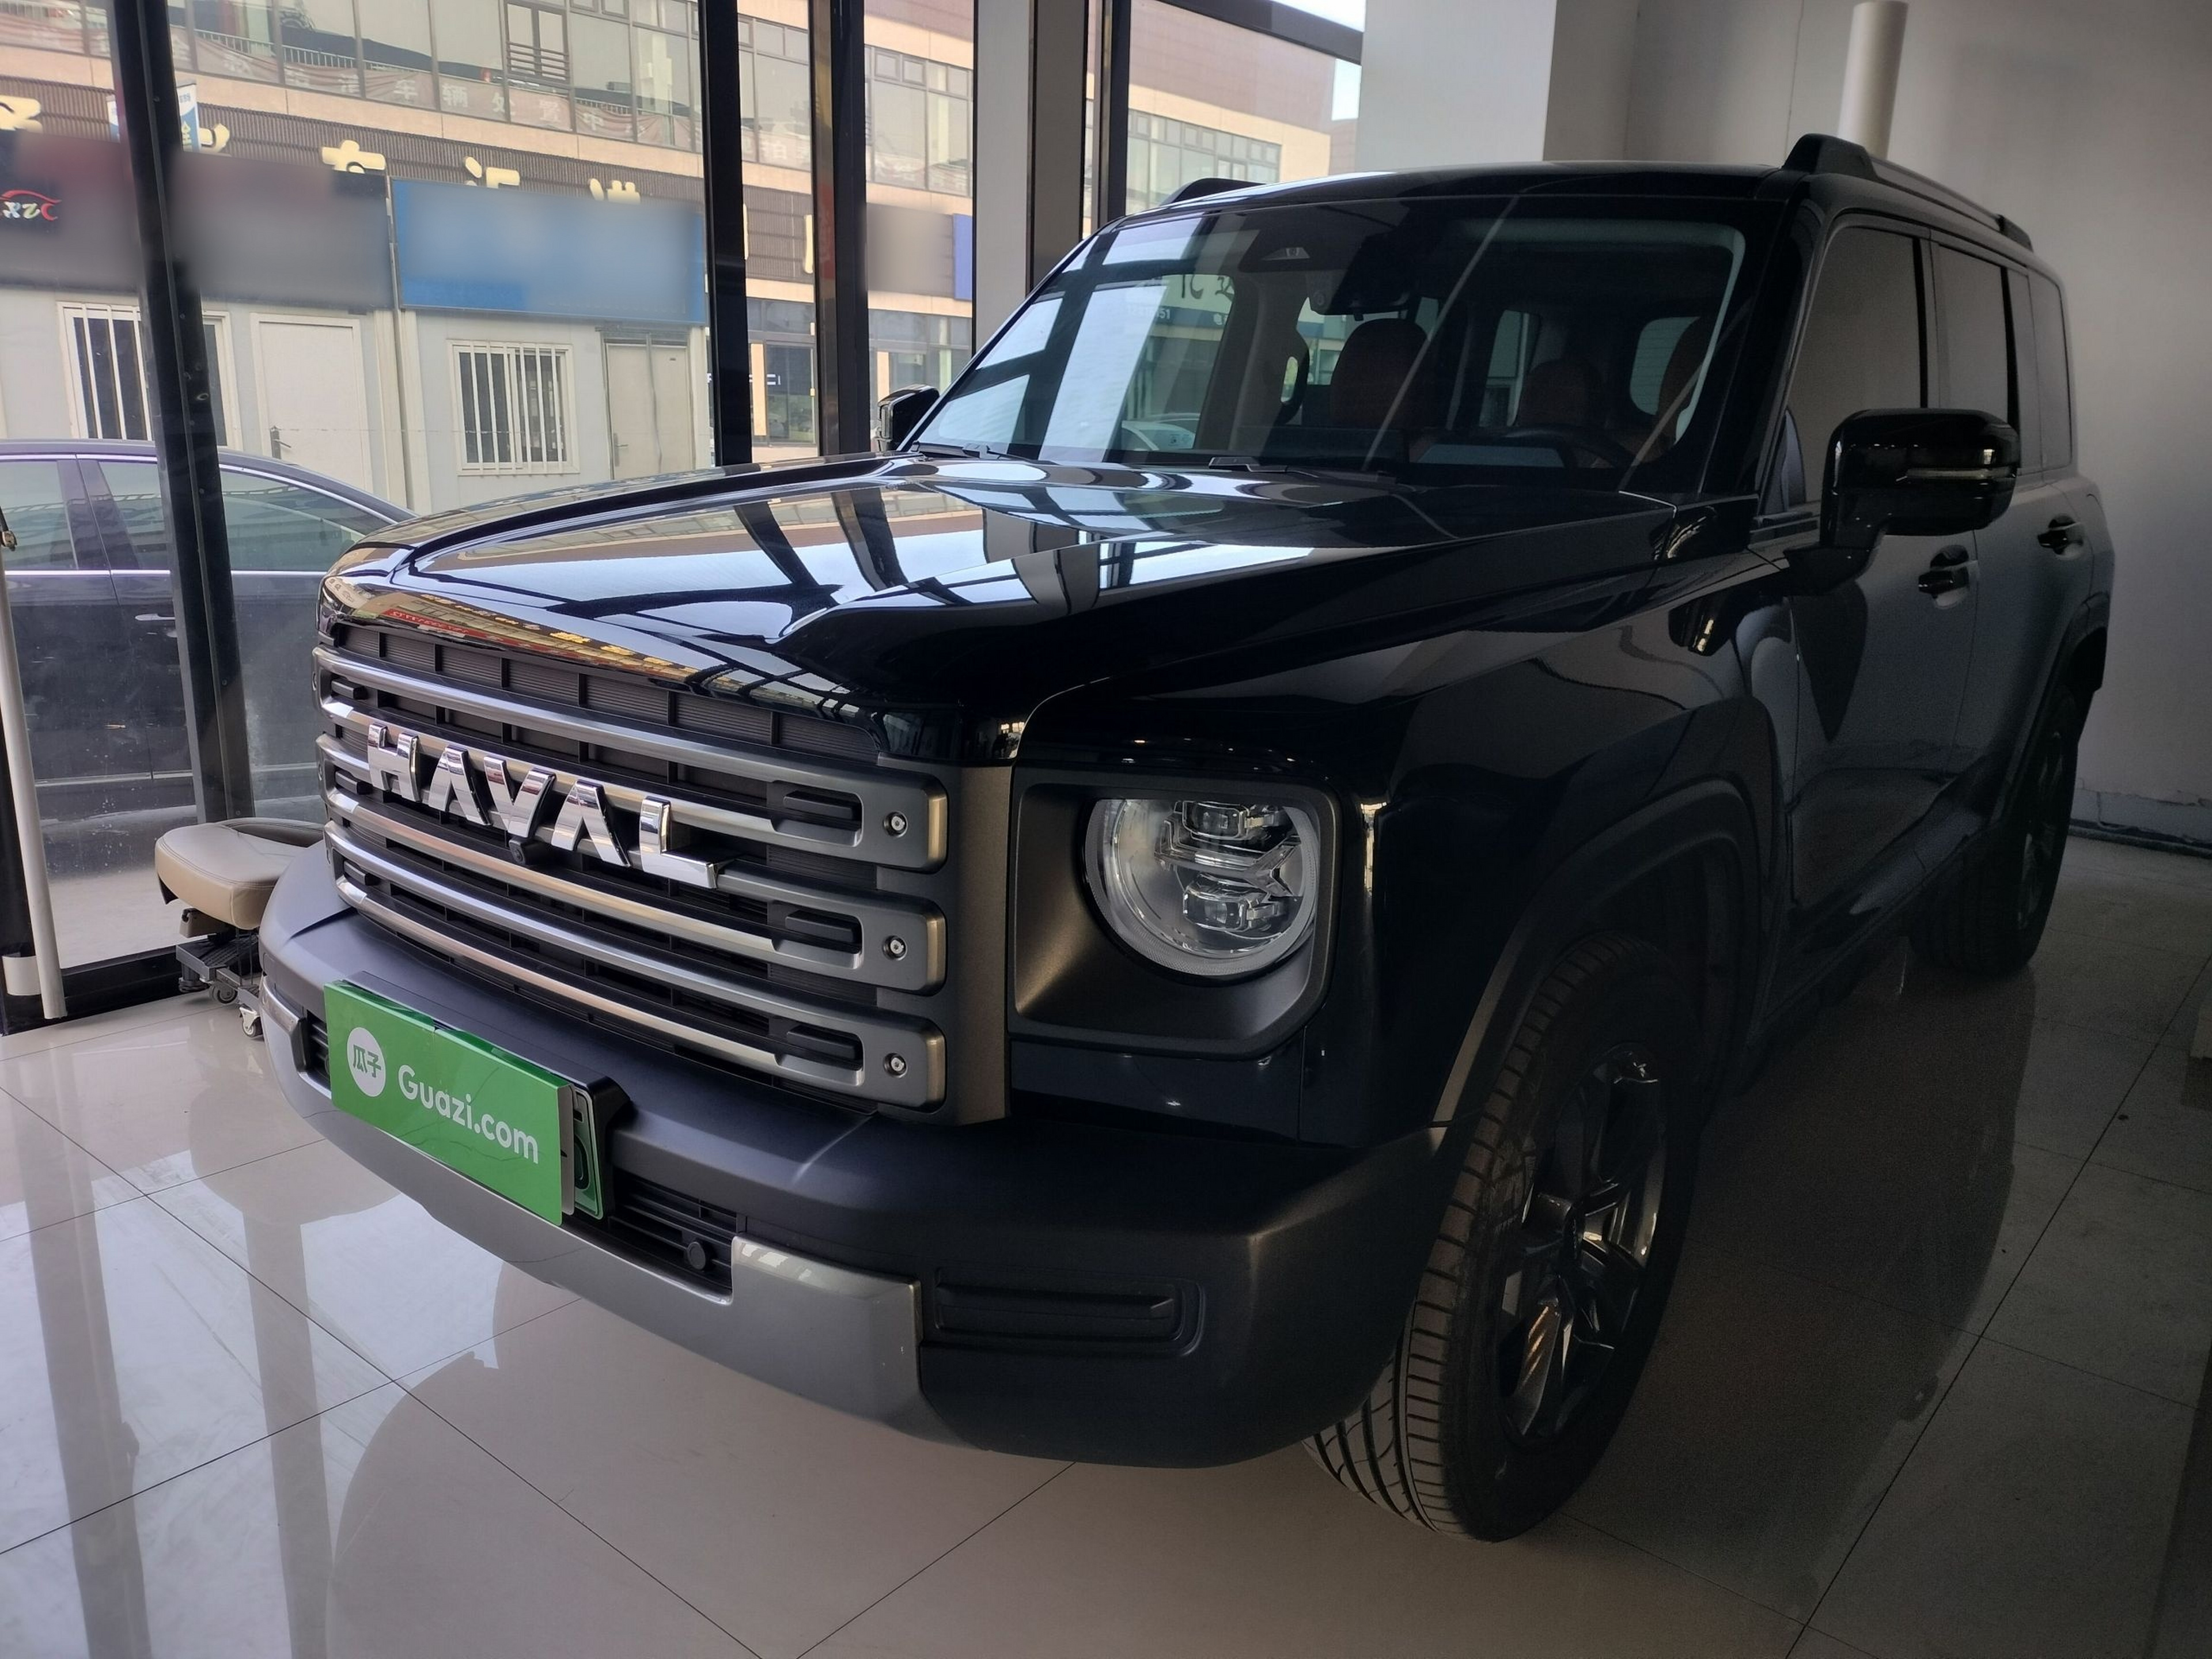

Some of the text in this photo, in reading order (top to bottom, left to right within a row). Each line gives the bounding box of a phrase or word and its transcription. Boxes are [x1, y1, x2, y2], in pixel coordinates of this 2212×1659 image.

[367, 722, 718, 889] HAVAL
[353, 1044, 381, 1078] 瓜子
[398, 1065, 539, 1164] Guazi.com
